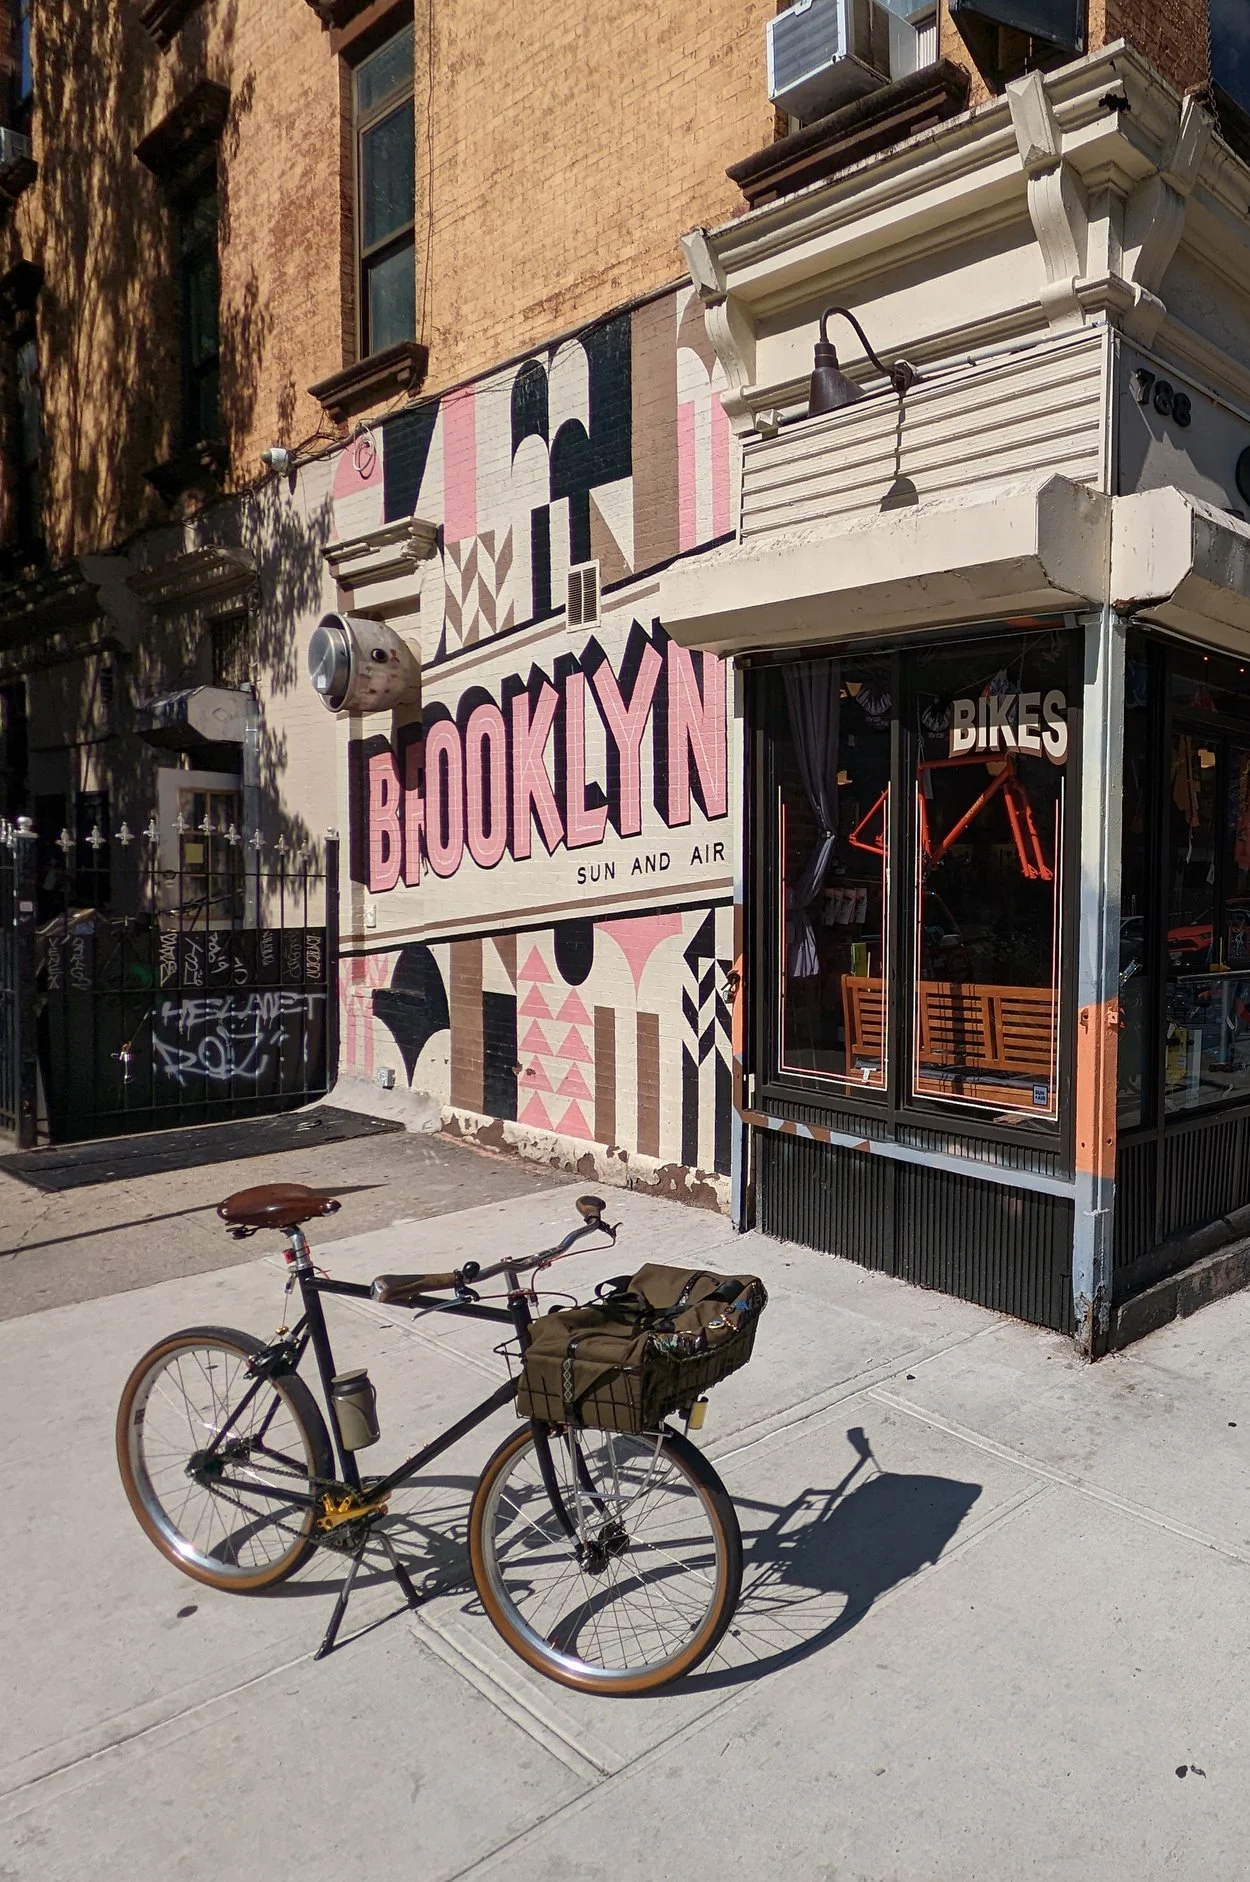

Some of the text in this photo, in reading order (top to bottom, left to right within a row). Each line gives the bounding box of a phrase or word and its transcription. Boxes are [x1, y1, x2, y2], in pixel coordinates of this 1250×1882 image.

[1131, 367, 1192, 428] 788
[951, 688, 1069, 762] BIKES
[366, 638, 729, 894] BROOKLYN
[577, 841, 726, 885] SUN AND AIR
